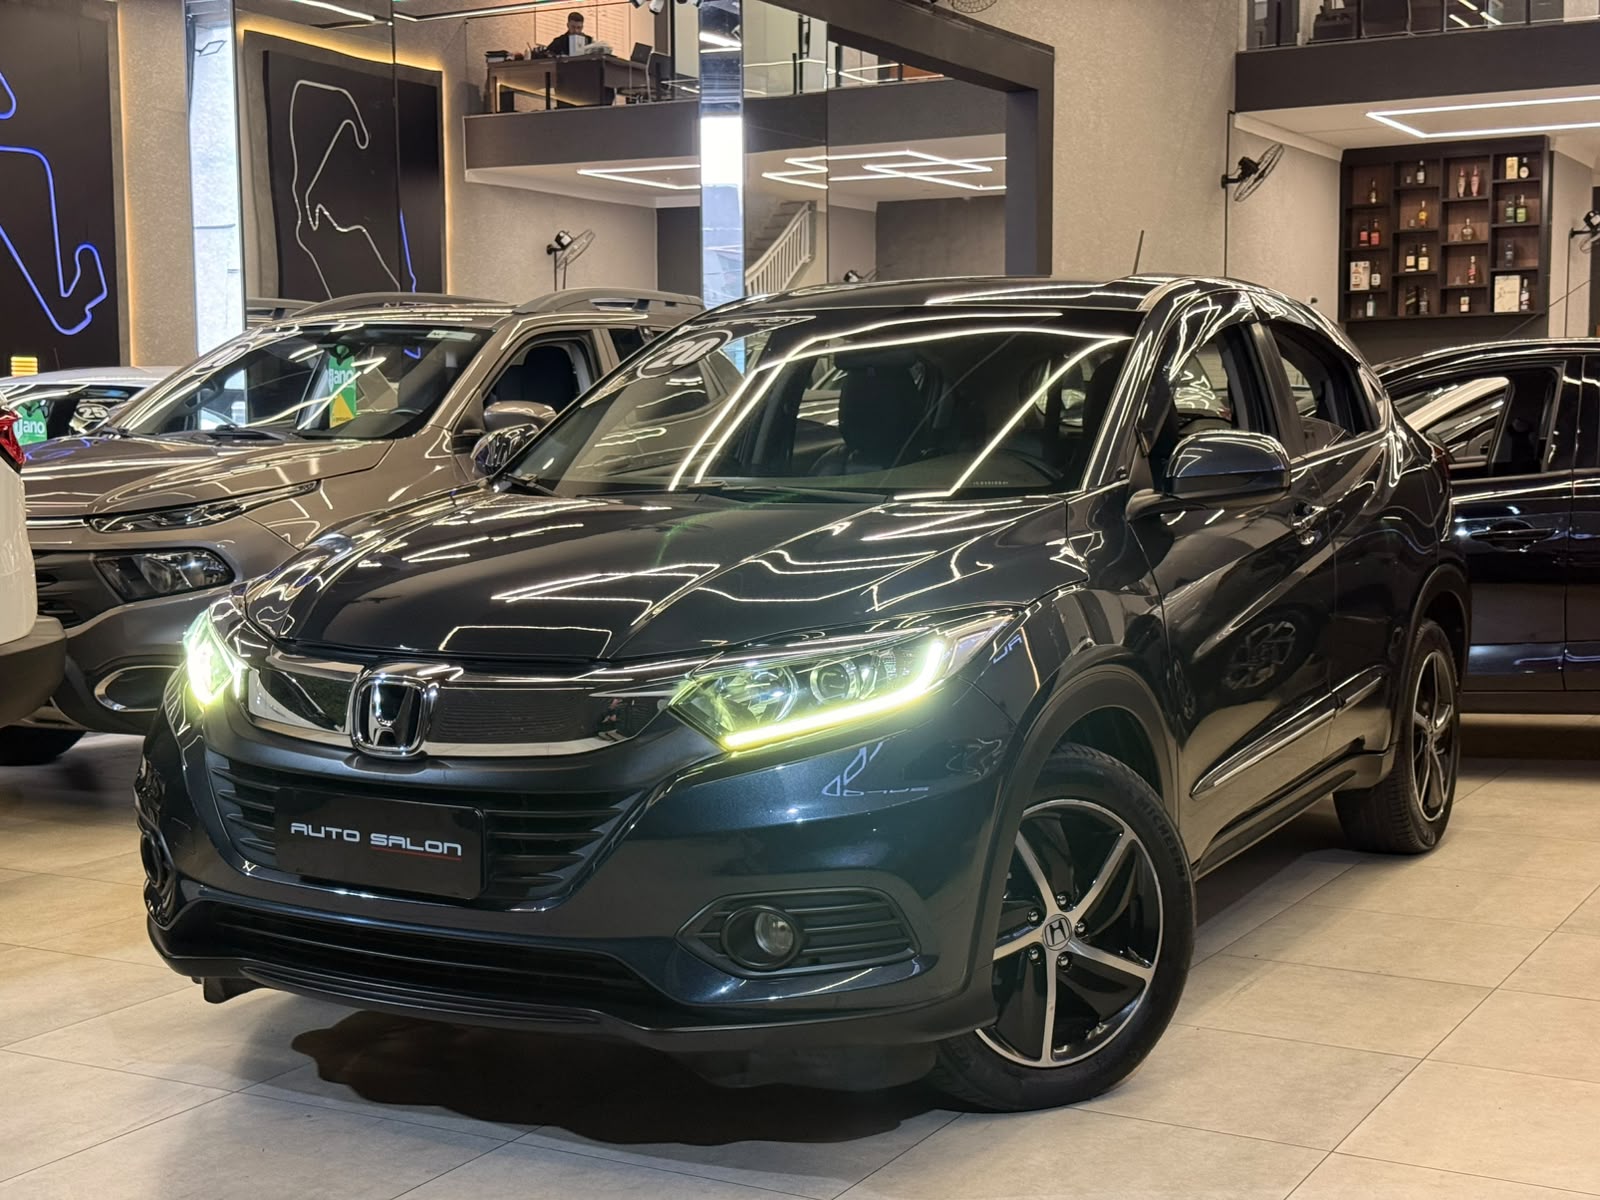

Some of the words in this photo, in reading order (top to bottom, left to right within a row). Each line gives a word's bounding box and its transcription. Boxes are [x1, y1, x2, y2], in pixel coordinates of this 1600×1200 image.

[645, 337, 721, 370] 20
[79, 407, 107, 418] 25
[290, 822, 360, 843] AUTO
[370, 833, 462, 857] SALON
